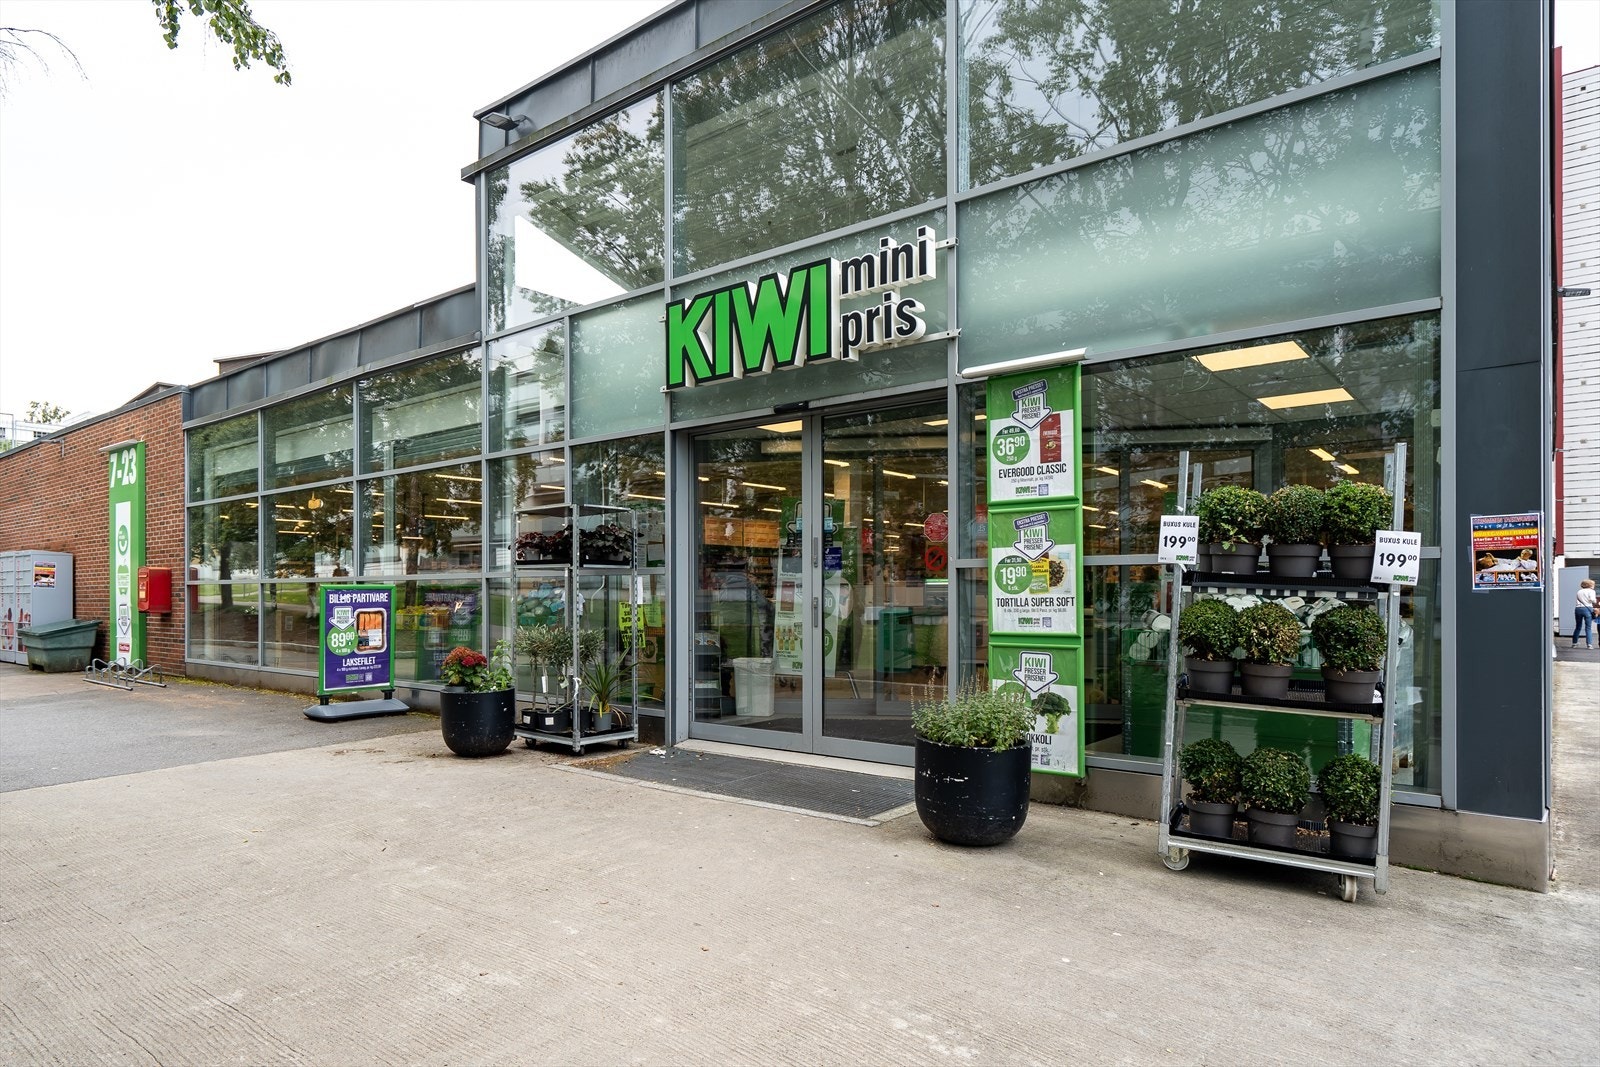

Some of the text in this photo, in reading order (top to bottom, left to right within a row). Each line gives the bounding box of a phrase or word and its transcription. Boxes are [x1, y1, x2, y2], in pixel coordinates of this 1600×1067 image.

[841, 226, 930, 297] mini
[666, 257, 833, 390] KIWI
[841, 291, 918, 360] pris
[1022, 397, 1040, 408] KIWI
[110, 448, 136, 488] 7-23
[999, 463, 1067, 478] EVERGOOD CLASSIC
[1024, 528, 1043, 538] KIWI
[352, 593, 388, 603] PARTIVARE
[996, 597, 1075, 608] TORTILLA SUPER SOFT
[343, 657, 376, 666] LAKSEFILET
[1025, 657, 1046, 668] KIWI
